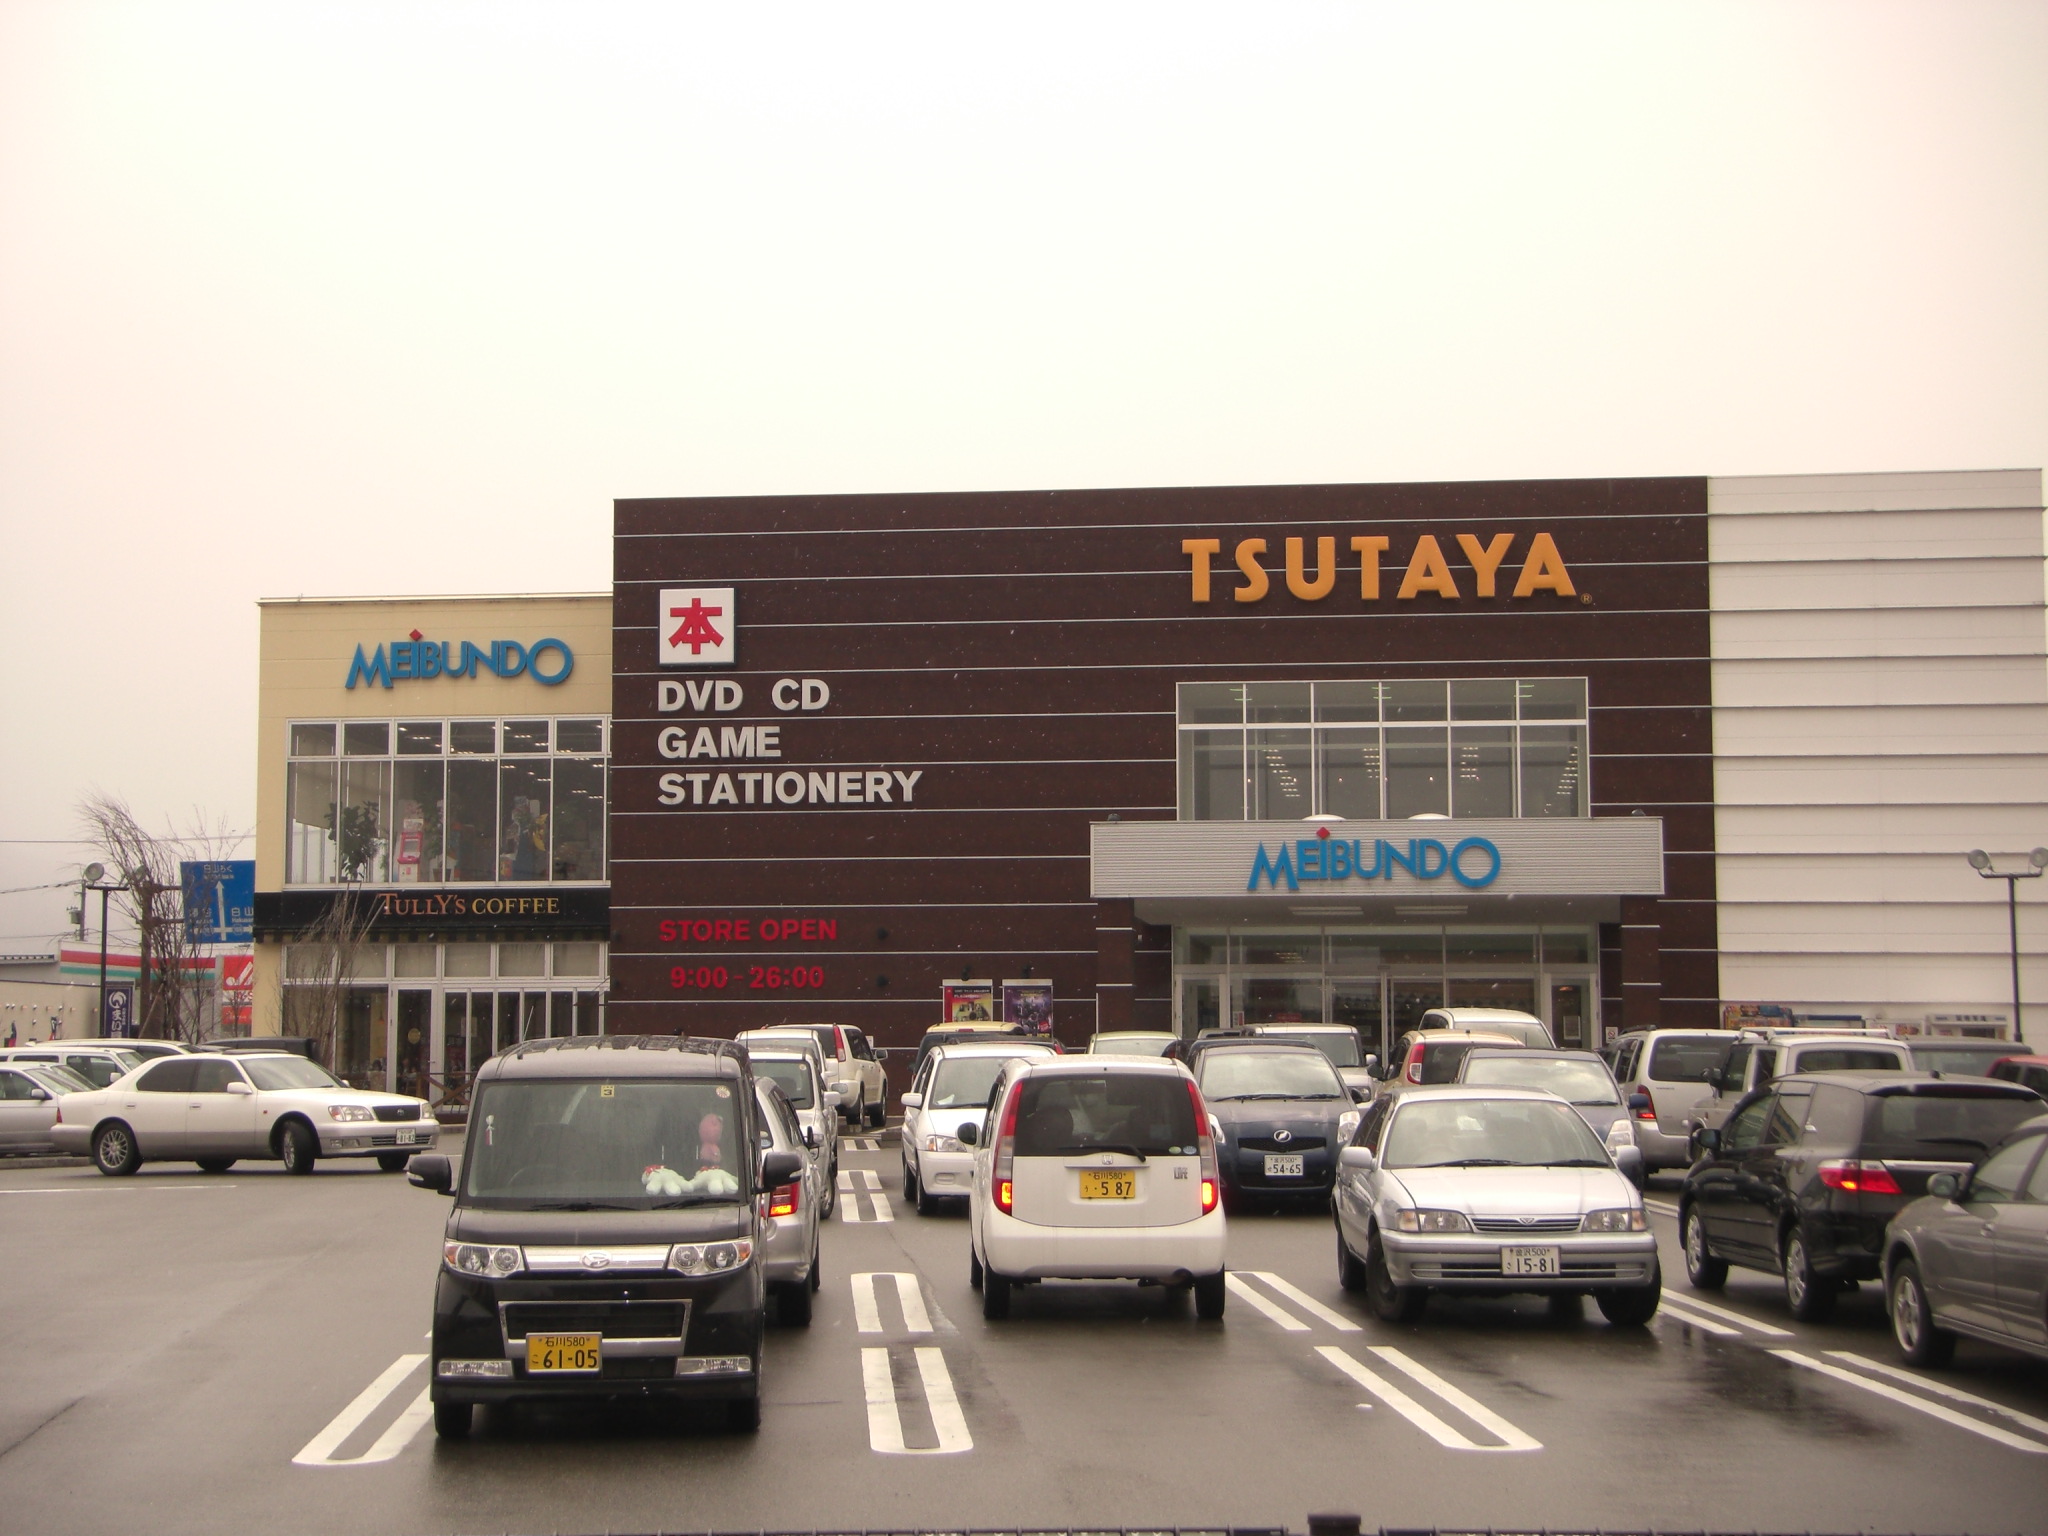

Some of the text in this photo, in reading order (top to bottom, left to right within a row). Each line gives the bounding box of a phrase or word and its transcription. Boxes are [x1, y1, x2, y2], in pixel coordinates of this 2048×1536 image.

[1181, 532, 1577, 603] TSUTAYA
[668, 597, 724, 655] 本
[344, 629, 574, 689] MEIBUNDO
[657, 678, 830, 712] DVD CD
[657, 726, 782, 759] GAME
[657, 770, 923, 806] STATIONERY
[1246, 826, 1502, 891] MEIBUNDO
[471, 898, 560, 915] COFFEE
[658, 919, 837, 942] STORE OPEN
[670, 966, 728, 989] 9:00
[750, 966, 825, 989] 26:00
[1093, 1172, 1123, 1180] 石川580
[1273, 1164, 1301, 1174] 54-65
[1516, 1258, 1554, 1272] 15-81
[545, 1336, 585, 1347] 石川580
[543, 1349, 598, 1368] 61-05
